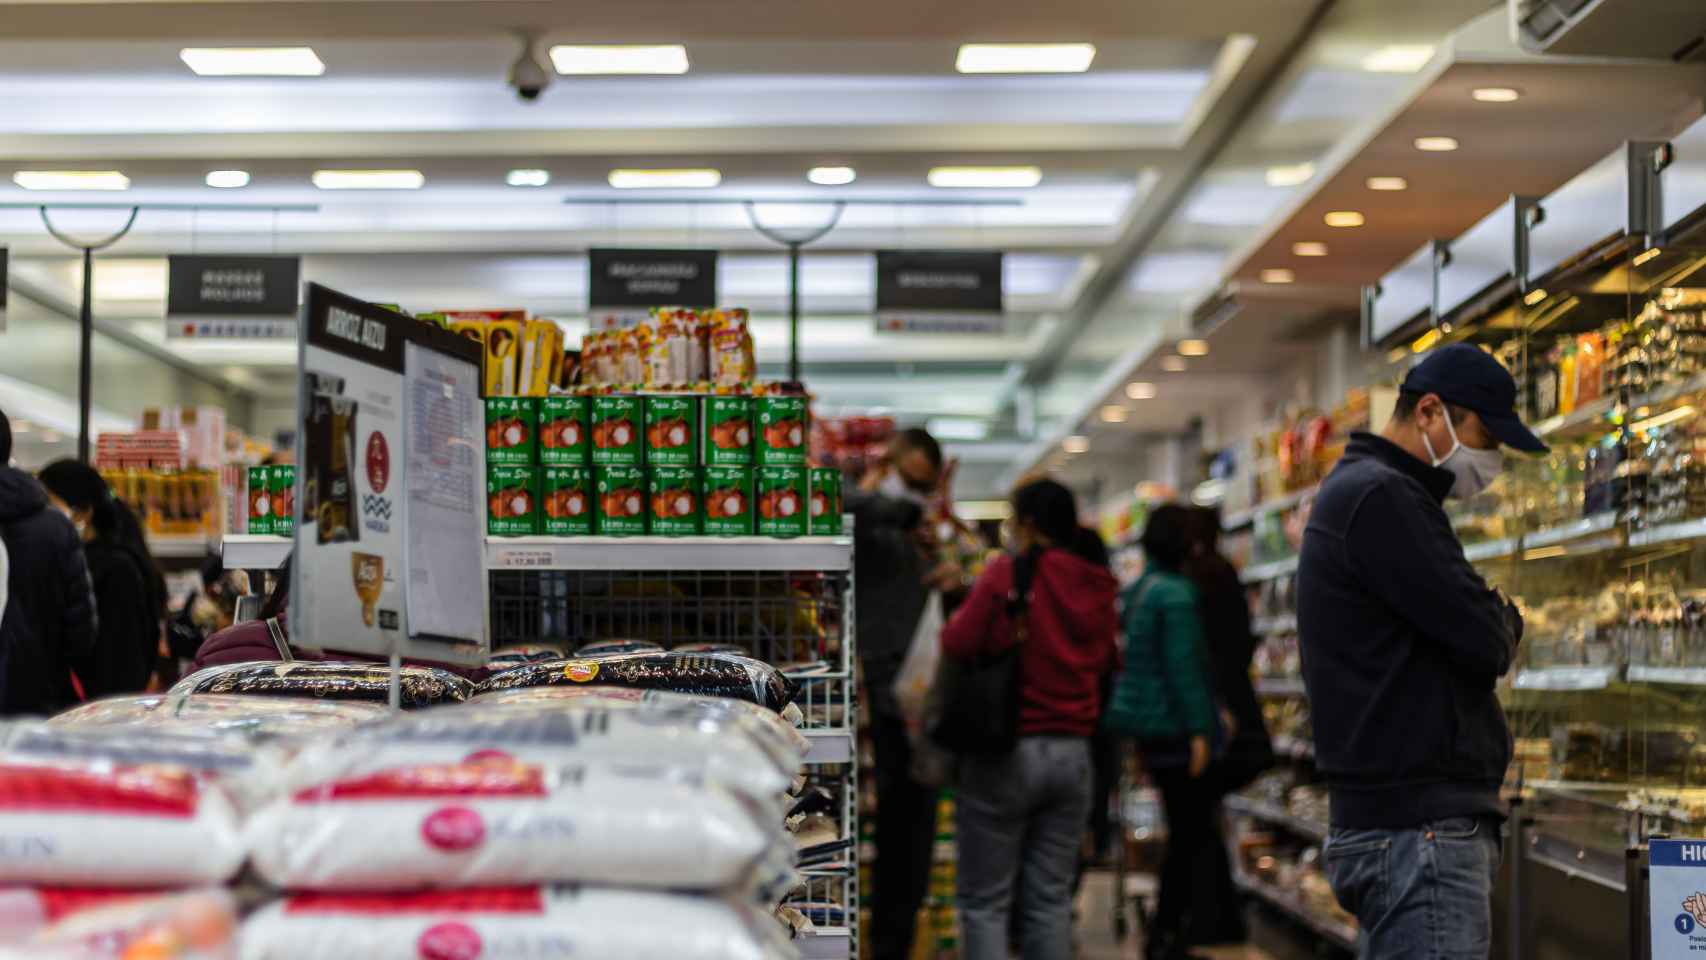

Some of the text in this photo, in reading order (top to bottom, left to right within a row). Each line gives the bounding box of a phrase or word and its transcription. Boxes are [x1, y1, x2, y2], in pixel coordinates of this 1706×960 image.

[326, 305, 361, 344] ARROZ
[361, 317, 386, 351] AIZU
[1681, 919, 1687, 930] 1
